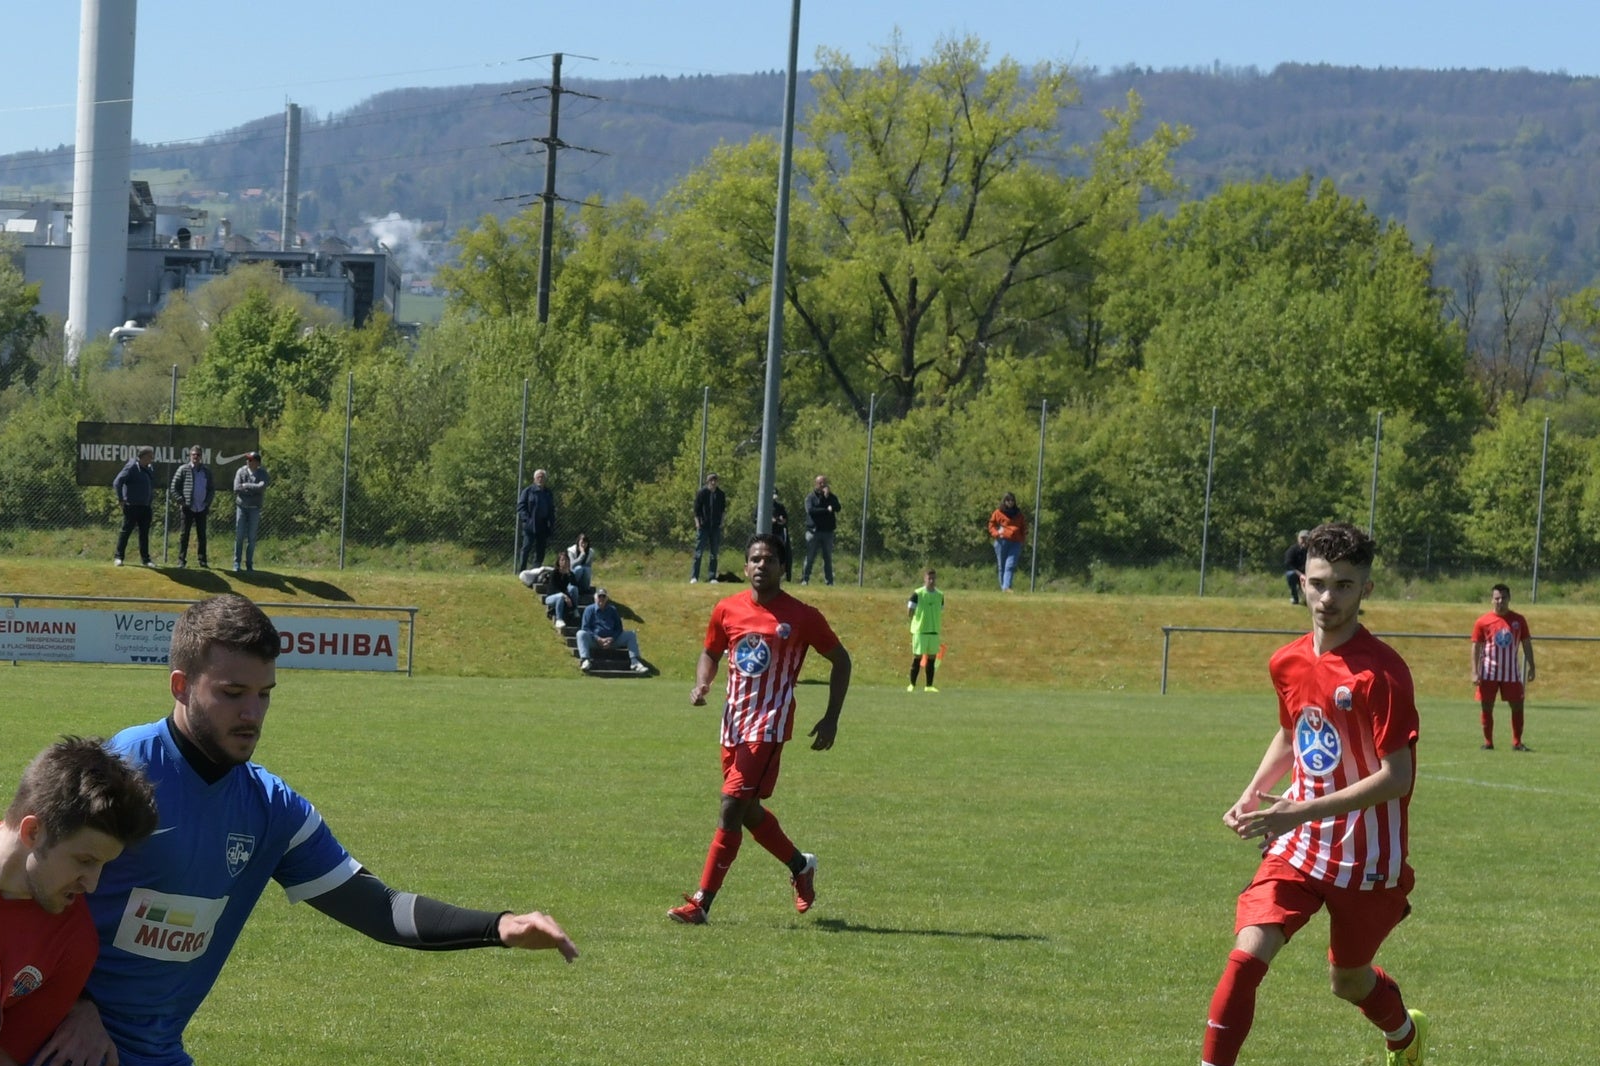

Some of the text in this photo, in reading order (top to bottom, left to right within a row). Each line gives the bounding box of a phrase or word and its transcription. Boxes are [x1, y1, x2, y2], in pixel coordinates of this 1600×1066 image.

[115, 613, 176, 632] Werbe
[279, 631, 393, 656] OSHIBA
[131, 655, 169, 663] www.d
[134, 924, 209, 952] MIGRO
